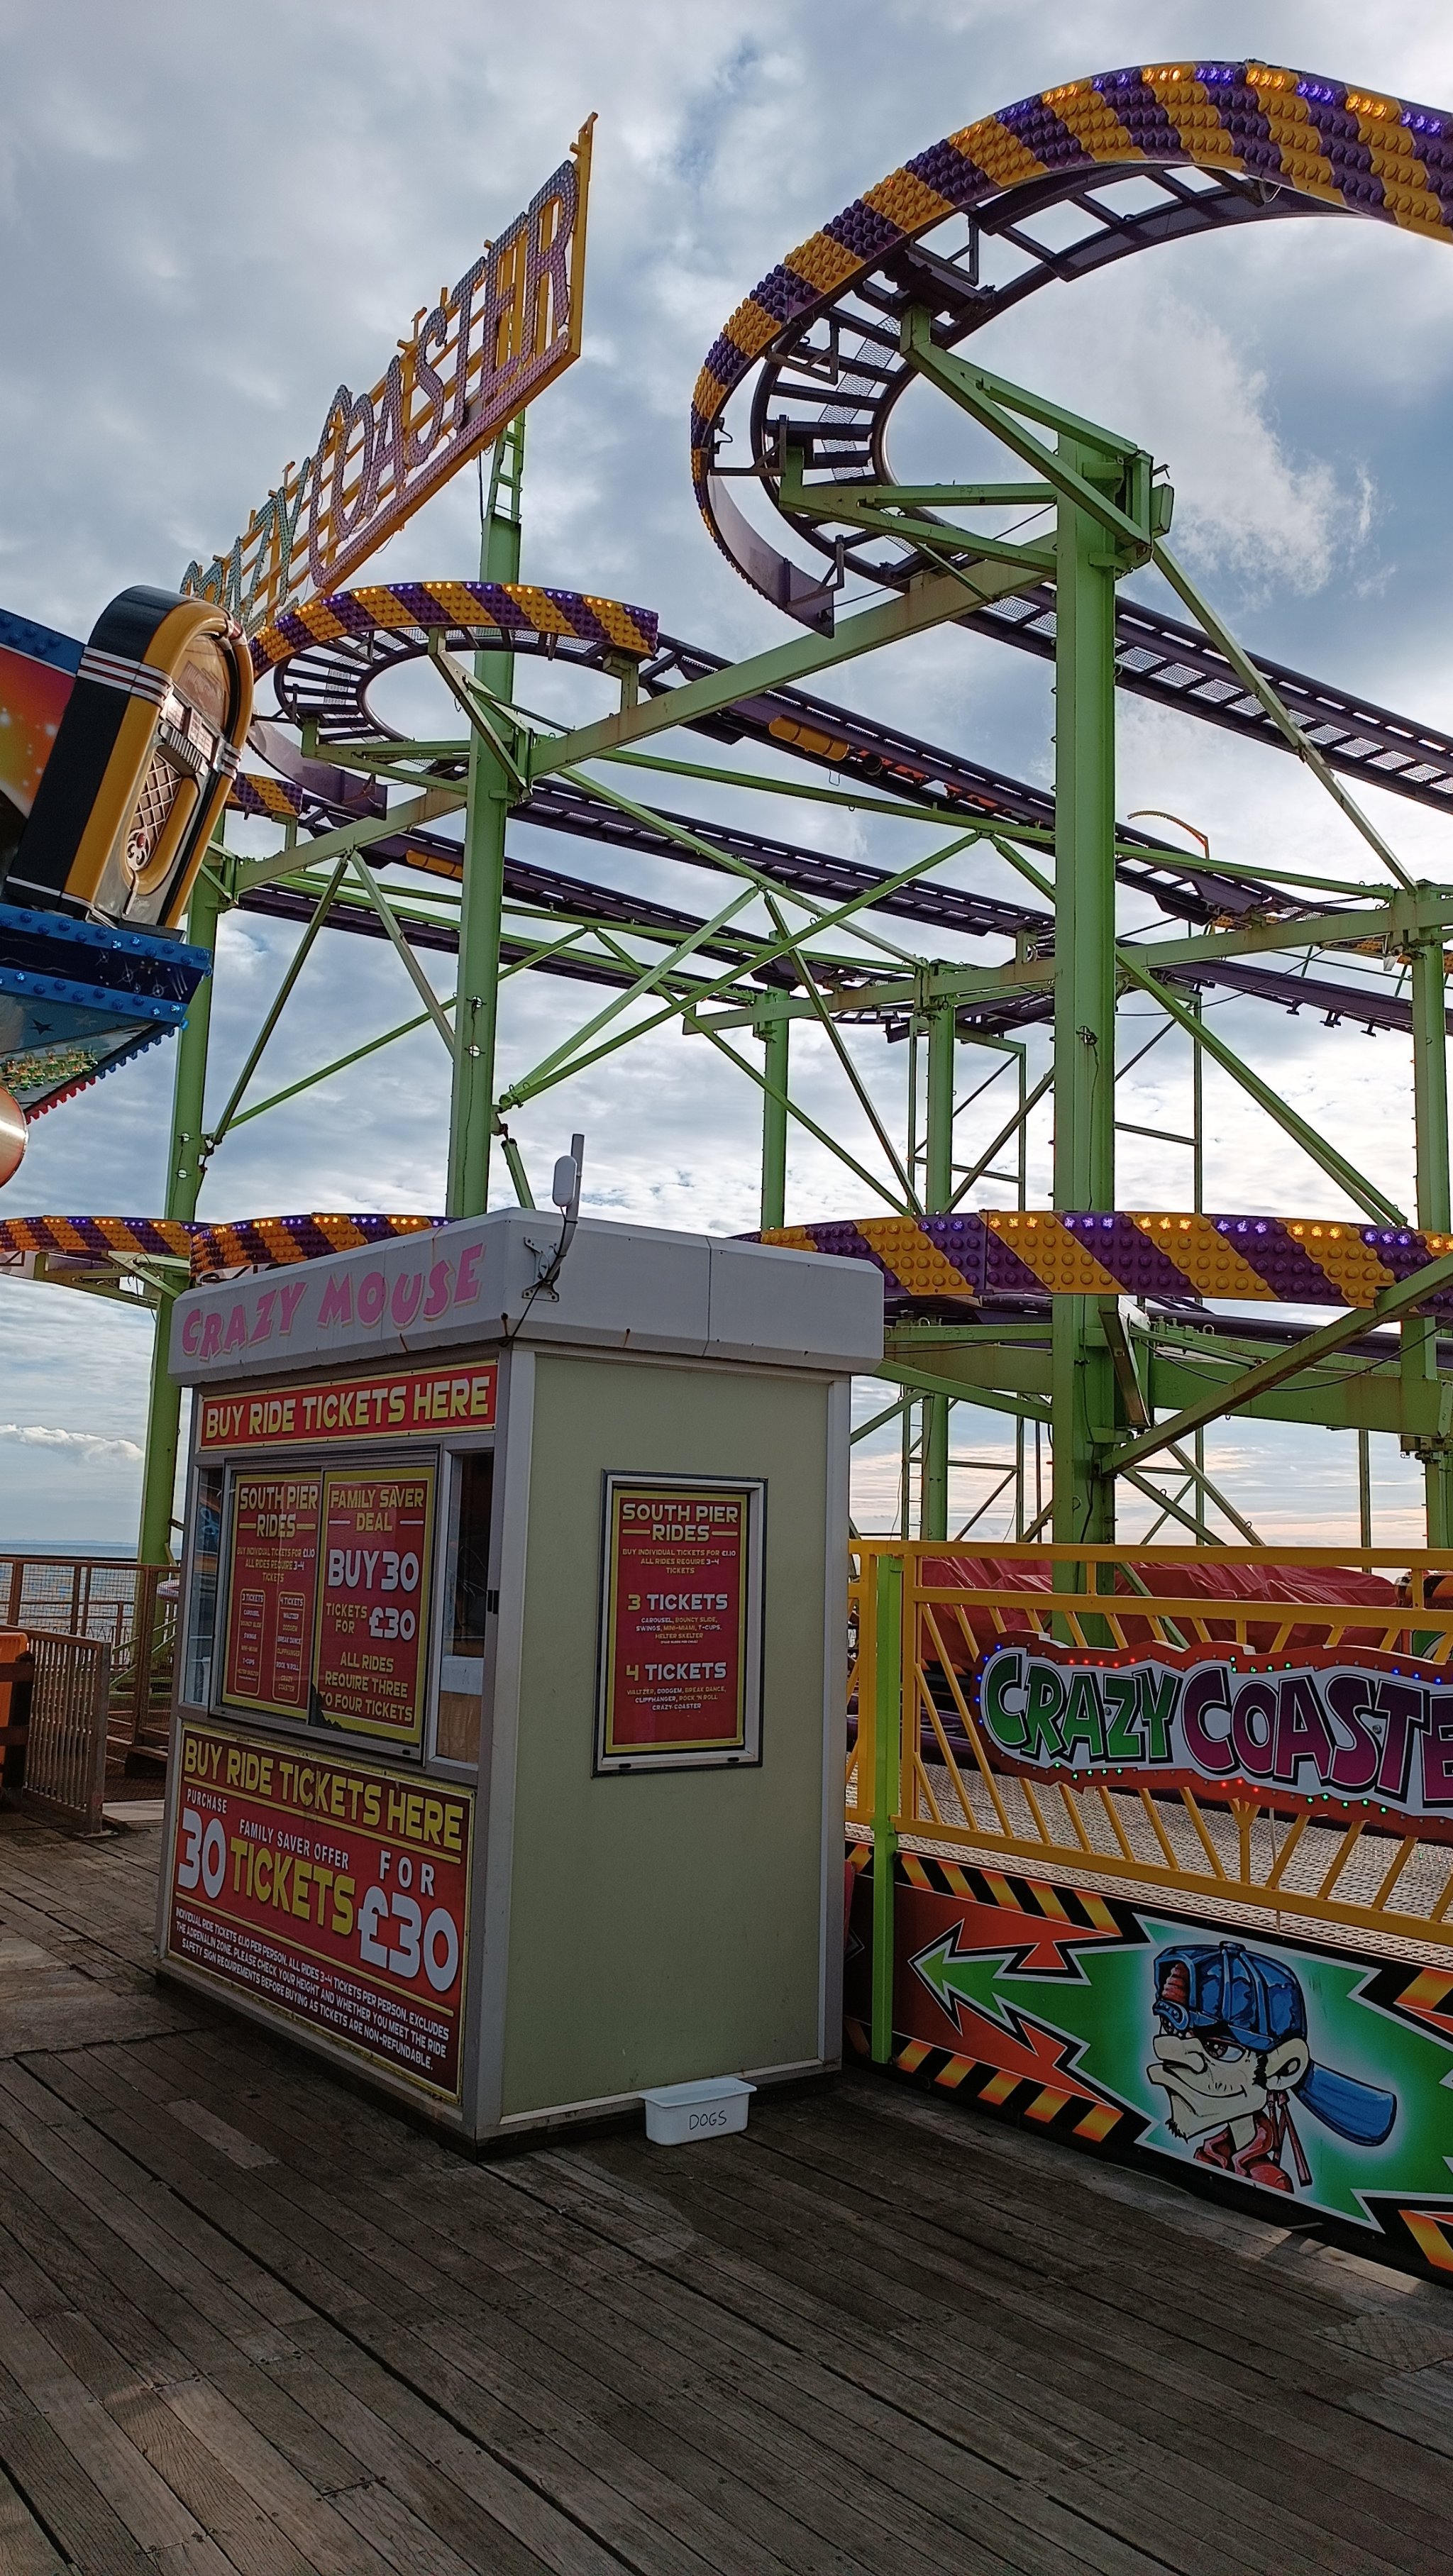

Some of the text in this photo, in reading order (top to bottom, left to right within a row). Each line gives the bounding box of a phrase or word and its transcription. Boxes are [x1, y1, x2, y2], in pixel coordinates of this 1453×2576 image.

[308, 160, 578, 588] COASTER
[182, 1242, 486, 1362] CRAZY MOUSE
[206, 1376, 490, 1439] BUY RIDE TICKETS HERE
[240, 1486, 318, 1510] SOUTH PIER
[330, 1488, 423, 1509] FAMILY SAVER
[256, 1513, 296, 1537] RIDES
[356, 1513, 392, 1532] DEAL
[622, 1503, 738, 1523] SOUTH PIER
[652, 1524, 709, 1541] RIDES
[237, 1547, 245, 1555] BUY
[246, 1547, 270, 1556] INDIVIDUAL
[271, 1548, 292, 1557] TICKETS
[292, 1549, 302, 1557] FOR
[245, 1559, 304, 1571] ALL RIDES REQUIRE 3-4
[328, 1549, 419, 1592] BUY 30
[263, 1572, 284, 1583] TICKETS
[284, 1598, 304, 1607] TICKETS
[326, 1602, 368, 1620] TICKETS
[627, 1593, 728, 1610] 3 TICKETS
[335, 1619, 354, 1634] FOR
[369, 1606, 416, 1641] £30
[340, 1652, 394, 1673] ALL RIDES
[626, 1662, 726, 1681] 4 TICKETS
[325, 1671, 408, 1698] REQUIRE THREE
[334, 1695, 362, 1713] FOUR
[365, 1701, 413, 1723] TICKETS
[984, 1649, 1183, 1764] CRAZY
[184, 1738, 463, 1850] BUY RIDE TICKETS HERE
[187, 1788, 228, 1814] PURCHASE
[239, 1818, 349, 1870] FAMILY SAVER OFFER
[177, 1807, 459, 1991] 30 TICKETS £30
[176, 1907, 201, 1927] INDIVIDUAL
[201, 1918, 214, 1933] RIDE
[214, 1923, 237, 1942] TICKETS
[250, 1940, 263, 1955] PER
[263, 1945, 288, 1967] PERSON.
[289, 1957, 301, 1972] ALL
[301, 1962, 319, 1980] RIDES
[319, 1971, 333, 1987] 3-4
[333, 1977, 362, 2000] TICKETS
[362, 1989, 377, 2007] PER
[377, 1996, 408, 2023] PERSON.
[409, 2012, 450, 2041] EXCLUDES
[176, 1920, 447, 2059] THE ADRENALIN ZONE. PLEASE CHECK YOUR HEIGHT AND WHETHER YOU MEET THE RIDE
[182, 1938, 433, 2071] SAFETY SIGN REQUIREMENTS BEFORE BUYING AS TICKETS ARE NON-REFUNDABLE.
[689, 2110, 727, 2130] DOGS
